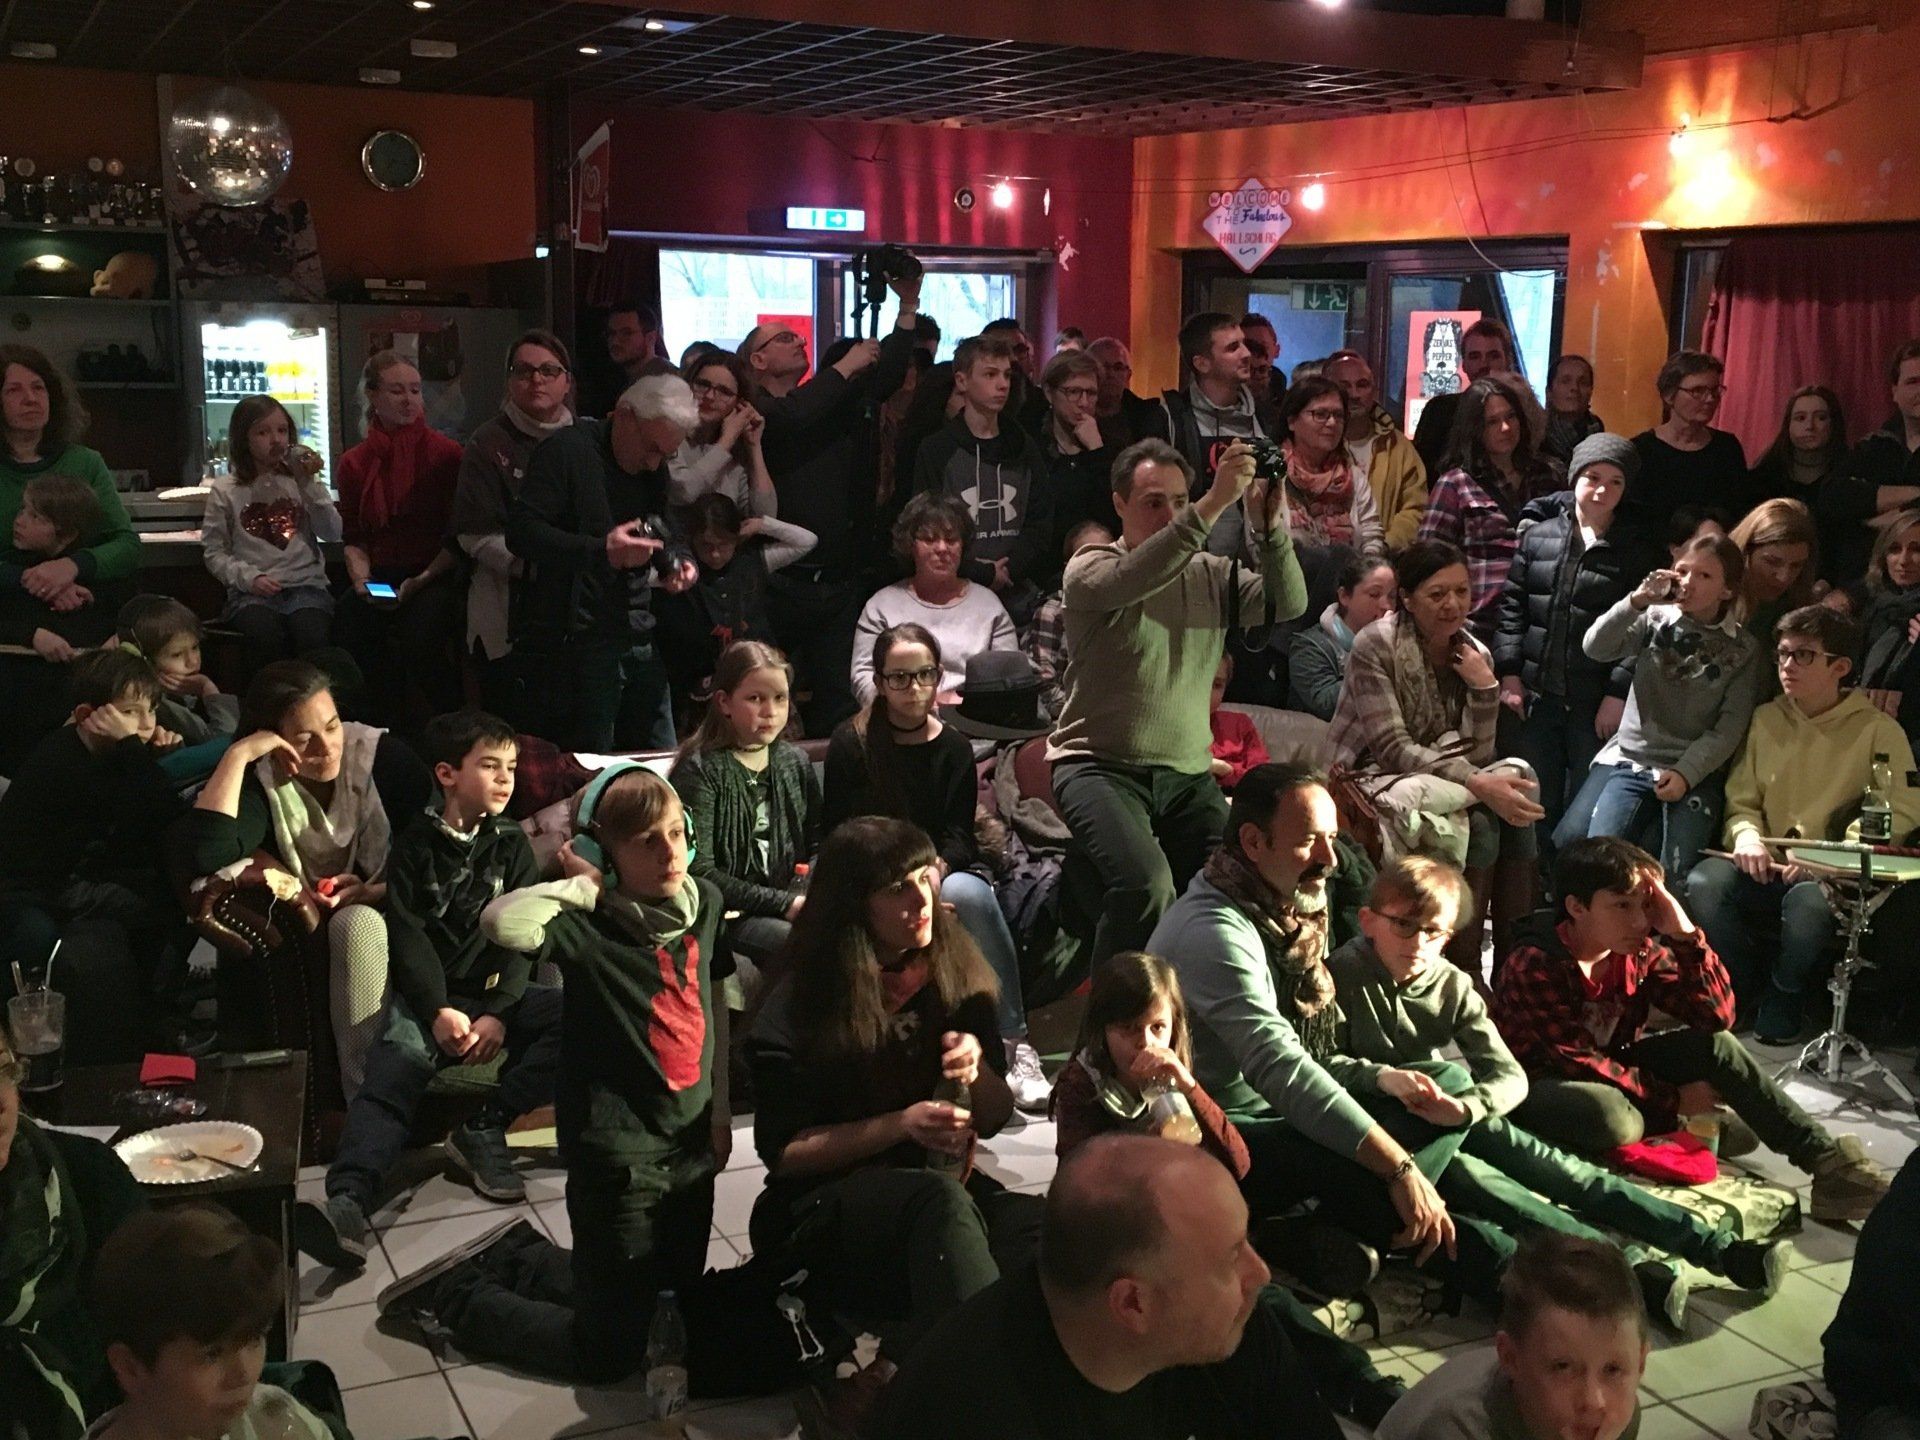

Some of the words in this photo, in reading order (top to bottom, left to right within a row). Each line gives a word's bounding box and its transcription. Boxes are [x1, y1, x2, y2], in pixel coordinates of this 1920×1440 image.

[1210, 190, 1290, 208] WELCOME
[1216, 215, 1240, 225] THE
[1432, 353, 1453, 361] PEPPER
